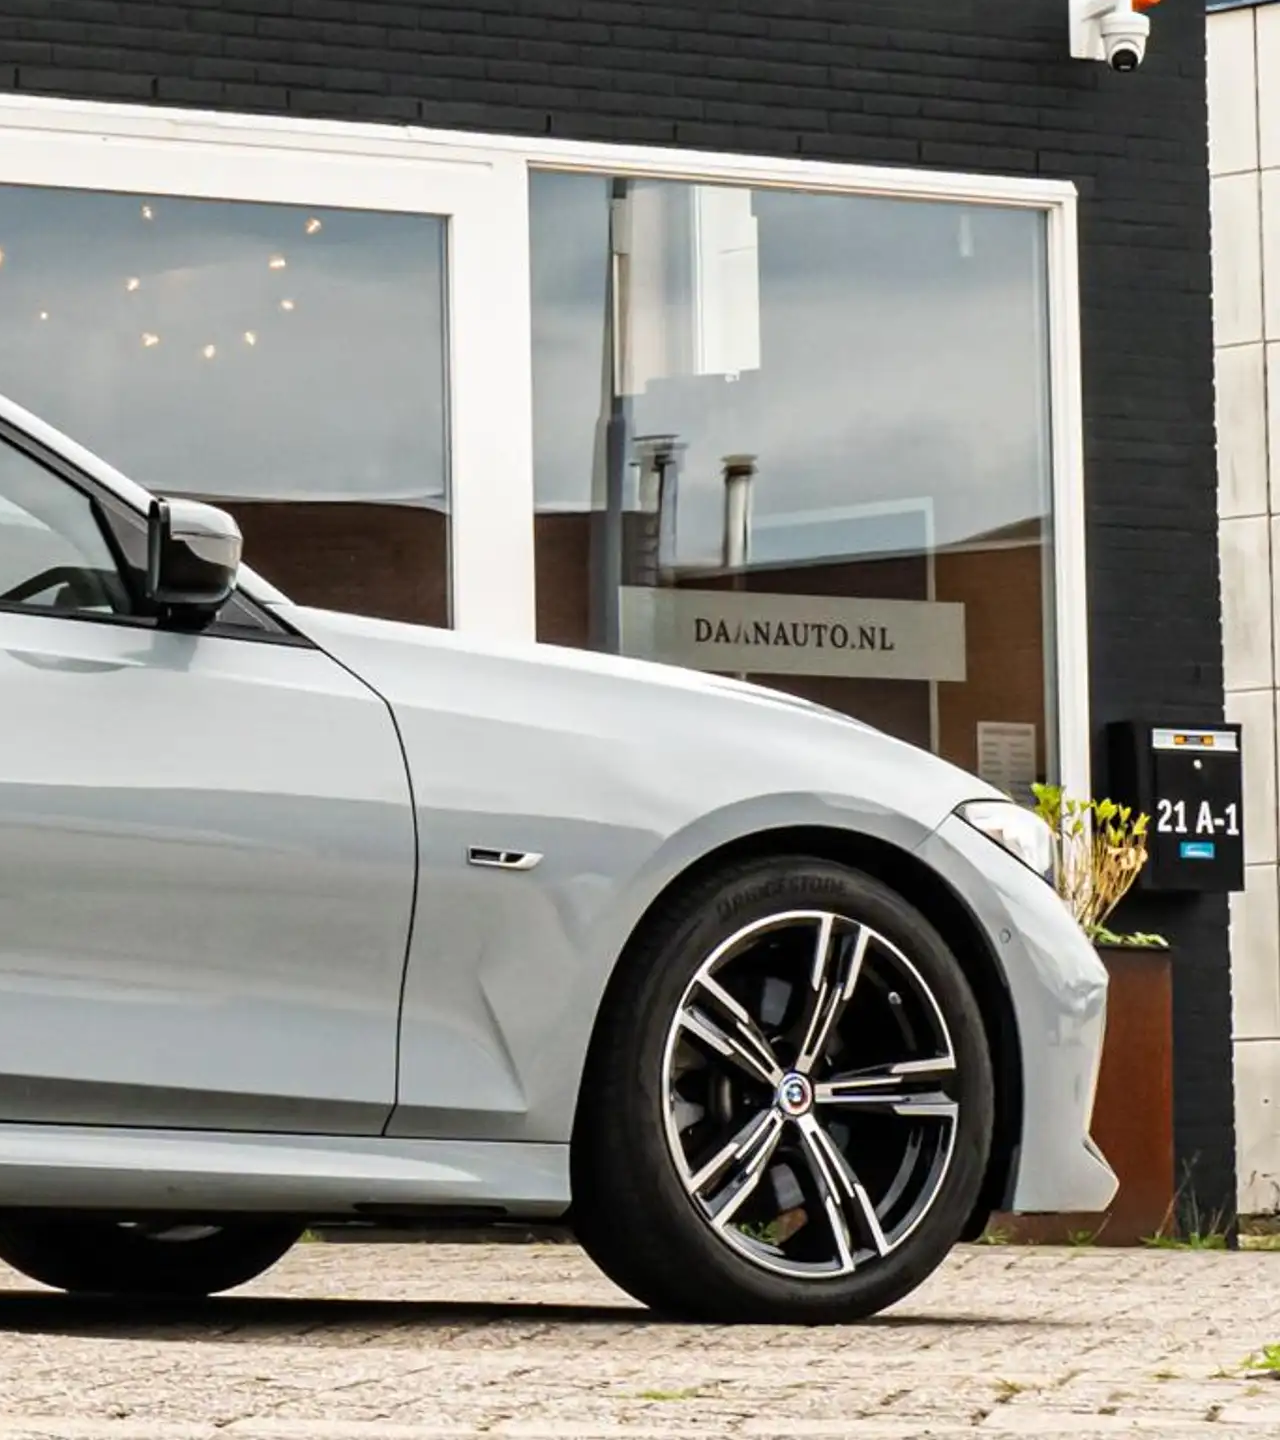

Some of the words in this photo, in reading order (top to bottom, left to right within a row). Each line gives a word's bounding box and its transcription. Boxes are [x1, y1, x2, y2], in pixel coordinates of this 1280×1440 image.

[694, 618, 895, 651] DAANAUTO.NL
[1157, 799, 1188, 833] 21
[1195, 801, 1240, 835] A-1
